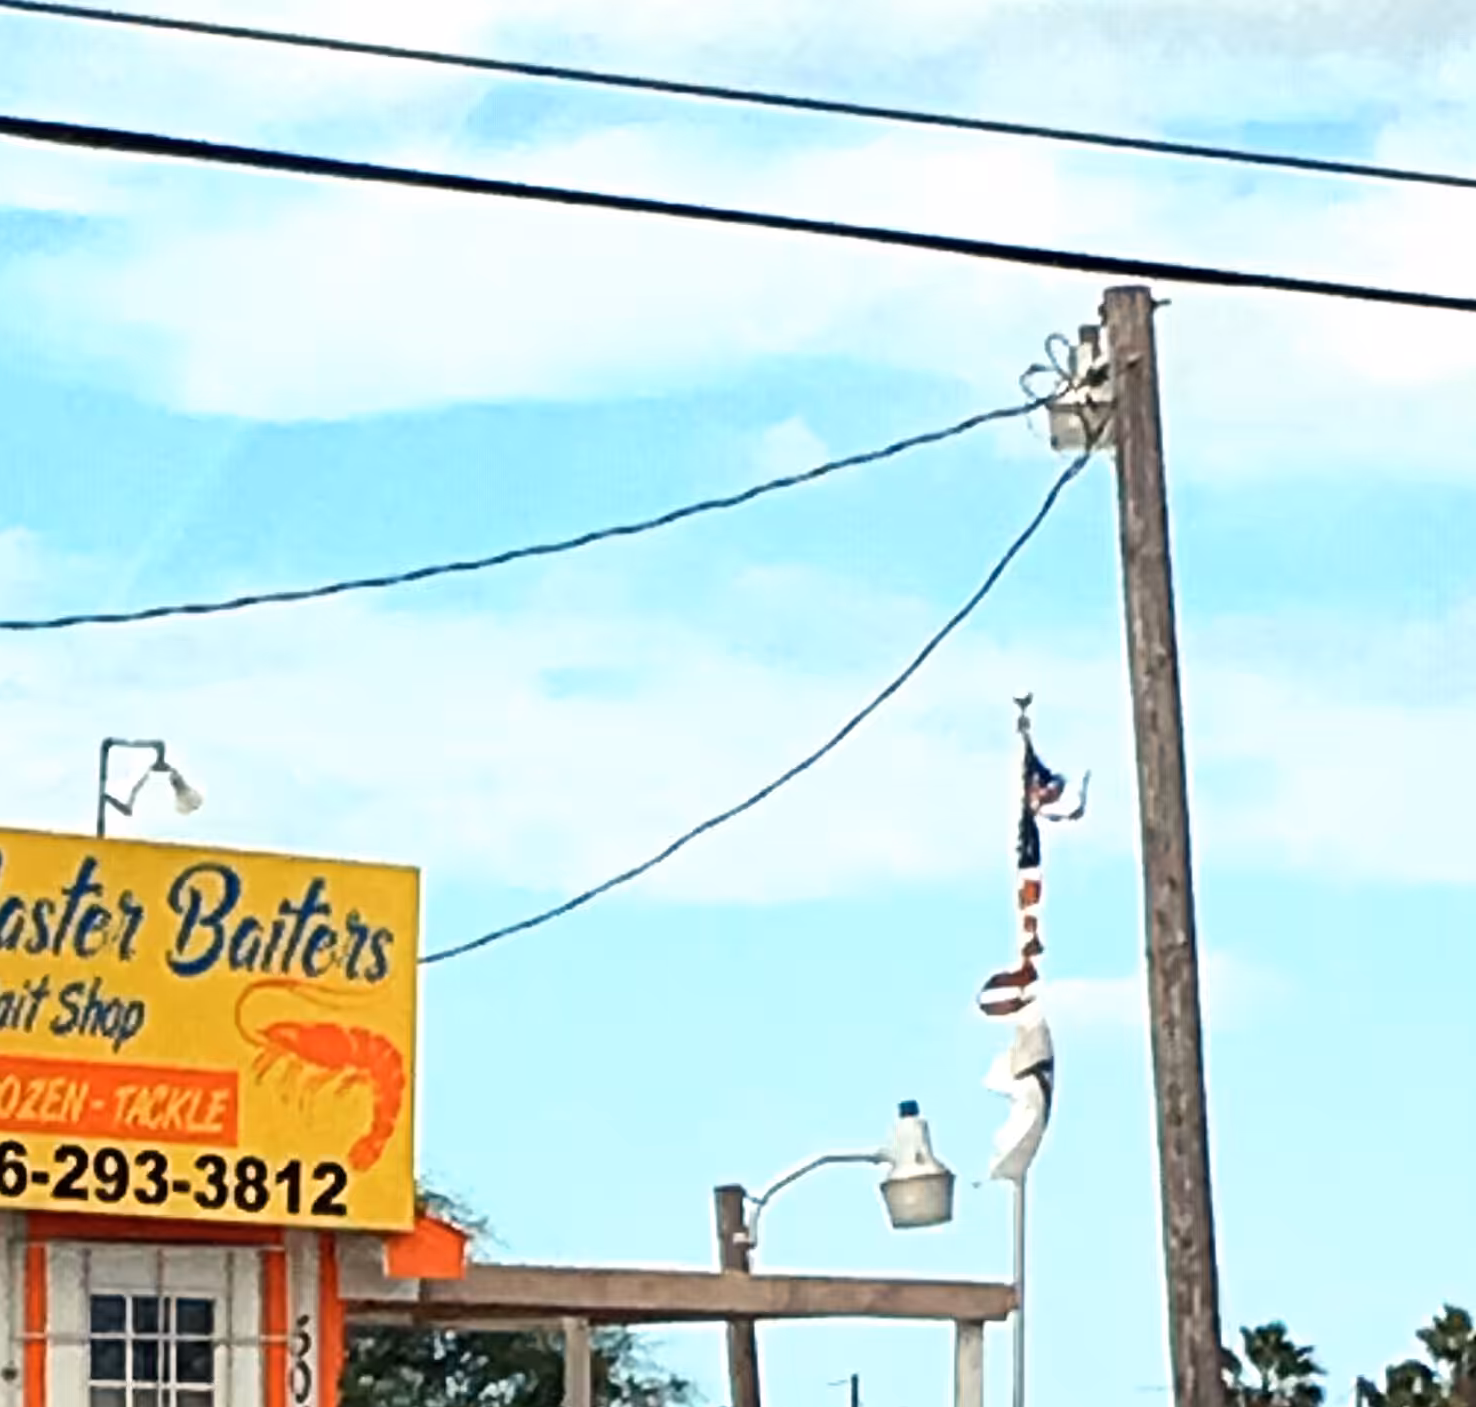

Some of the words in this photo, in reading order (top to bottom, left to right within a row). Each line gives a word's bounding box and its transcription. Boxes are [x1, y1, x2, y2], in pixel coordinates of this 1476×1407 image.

[165, 862, 394, 984] Baiters
[49, 976, 145, 1053] Shop
[113, 1086, 230, 1133] TACKLE
